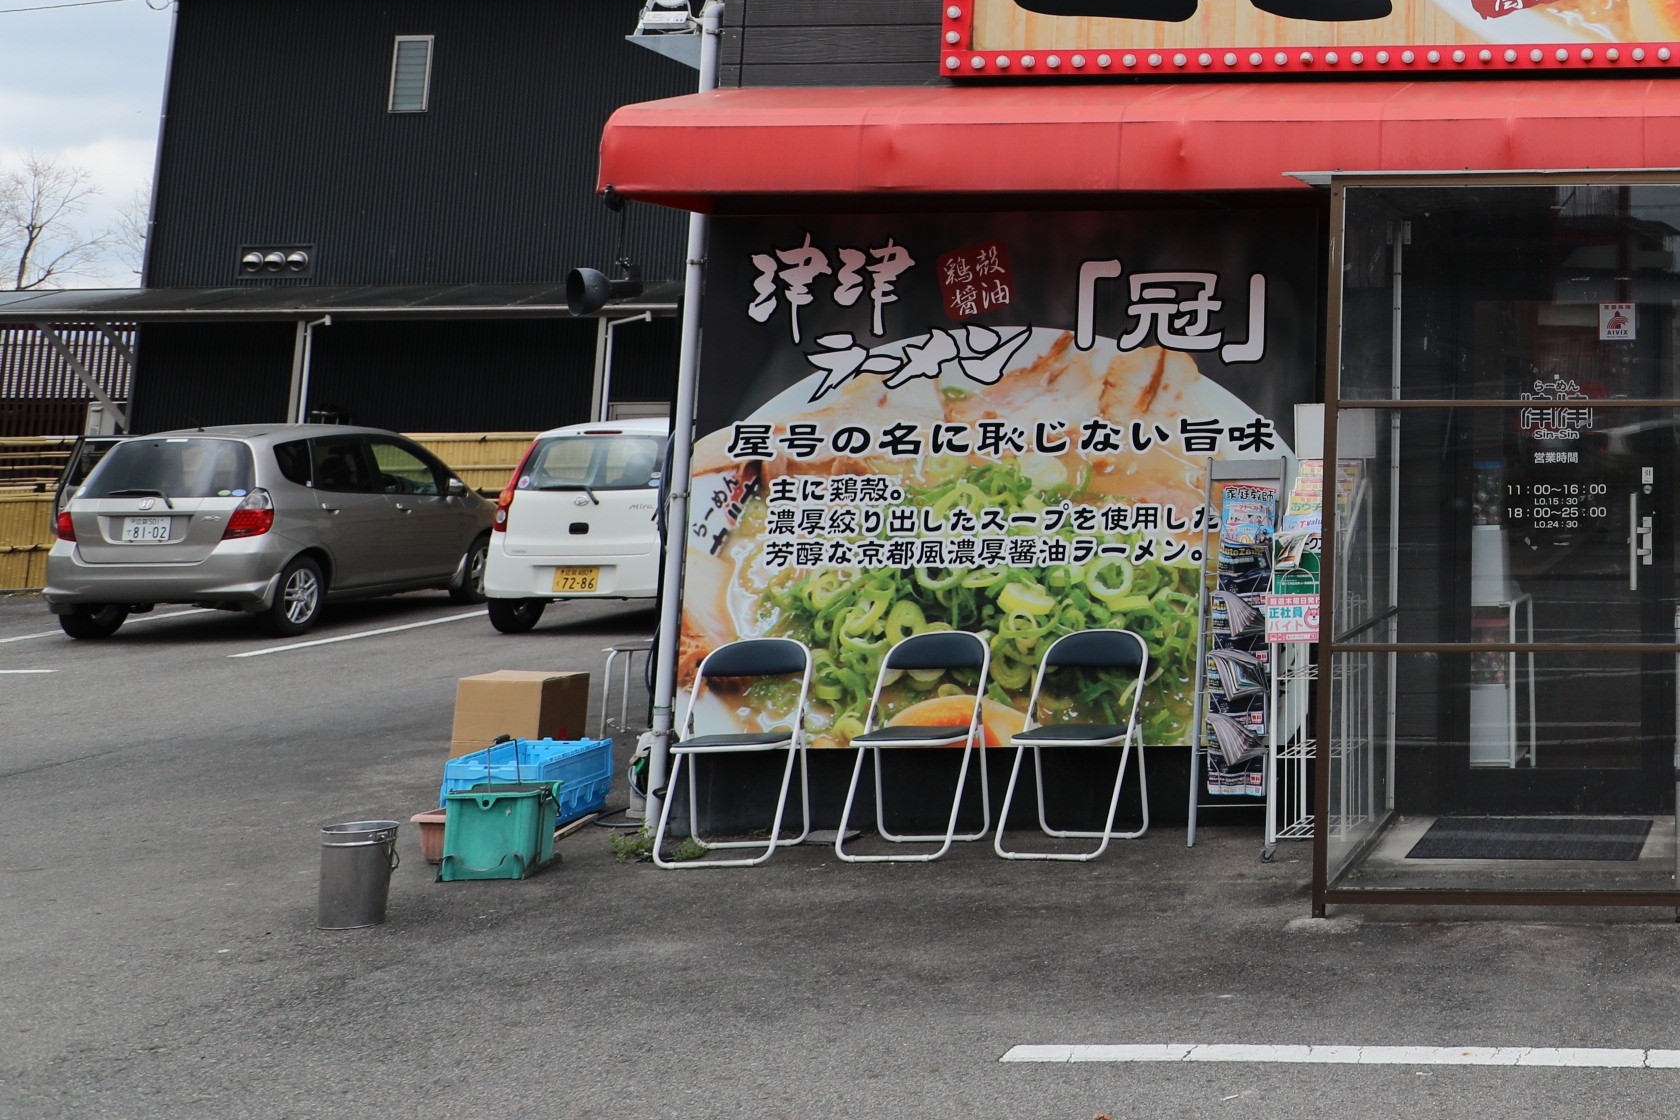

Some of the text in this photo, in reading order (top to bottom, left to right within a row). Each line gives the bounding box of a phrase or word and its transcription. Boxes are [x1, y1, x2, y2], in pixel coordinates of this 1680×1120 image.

[747, 233, 915, 345] 津津
[807, 322, 1032, 404] ラーメン
[1534, 380, 1580, 391] らーめん
[726, 417, 1275, 459] 屋号の名に恥じない旨味
[1534, 428, 1580, 440] Sin-Sin
[1534, 452, 1579, 464] 営業時間
[769, 478, 903, 504] 主に鶏殻。
[1226, 487, 1274, 501] 家庭教師
[692, 476, 740, 538] らーめん
[767, 502, 1221, 535] 濃厚絞り出したスープを使用した
[132, 527, 167, 539] 81-02
[765, 538, 1204, 568] 芳醇な京都風濃厚醤油ラーメン。
[562, 577, 595, 590] 72-86
[1269, 607, 1303, 619] 正社員
[1269, 620, 1303, 632] バイト
